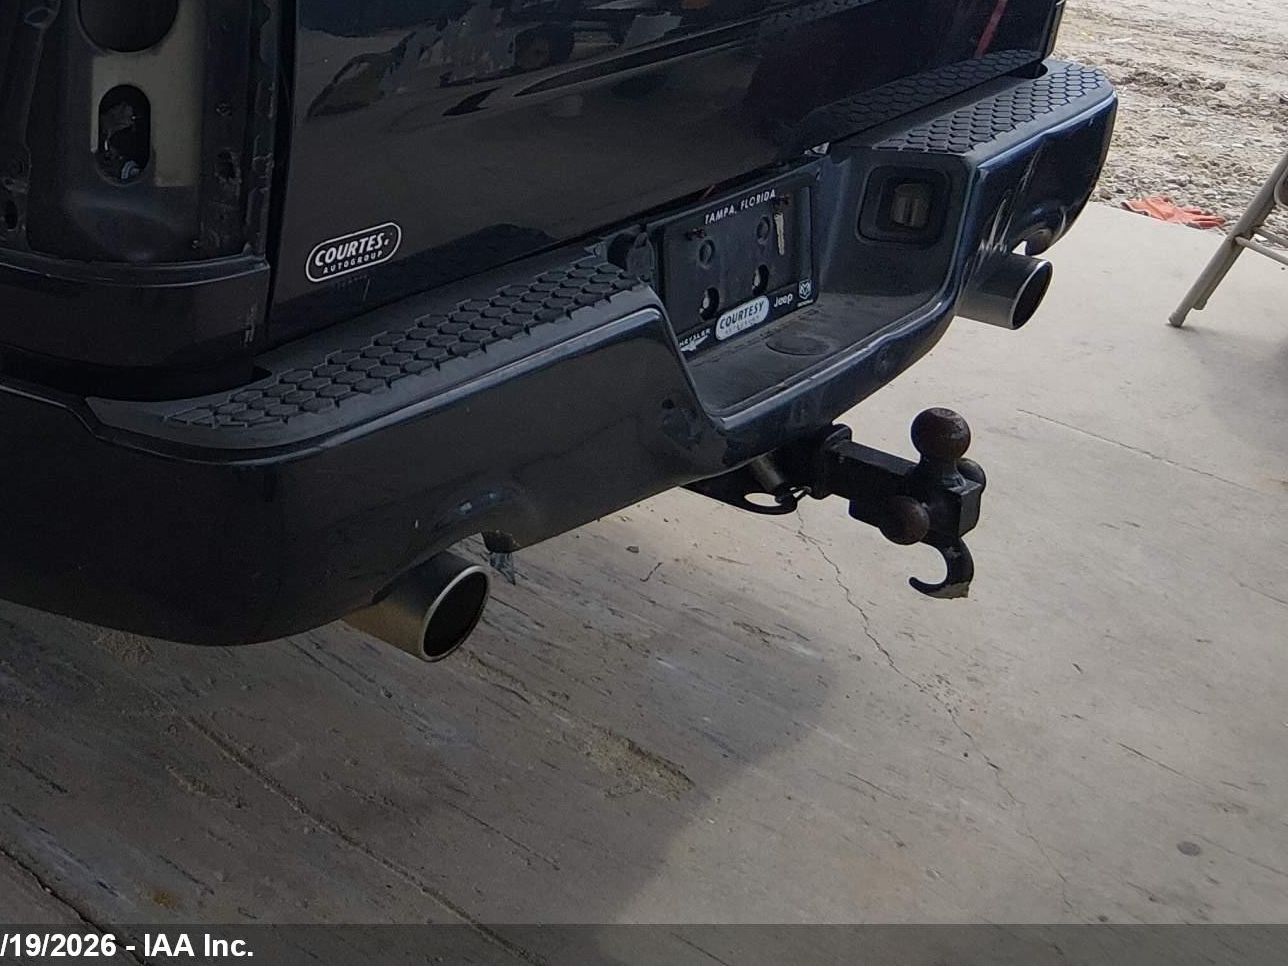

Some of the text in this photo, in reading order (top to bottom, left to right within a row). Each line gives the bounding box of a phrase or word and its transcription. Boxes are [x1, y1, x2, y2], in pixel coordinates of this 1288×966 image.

[740, 189, 777, 210] FLORIDA
[314, 232, 390, 266] COURTES
[322, 250, 384, 274] AUTOGROUP
[773, 293, 793, 308] Jeep
[719, 300, 765, 330] COURTESY
